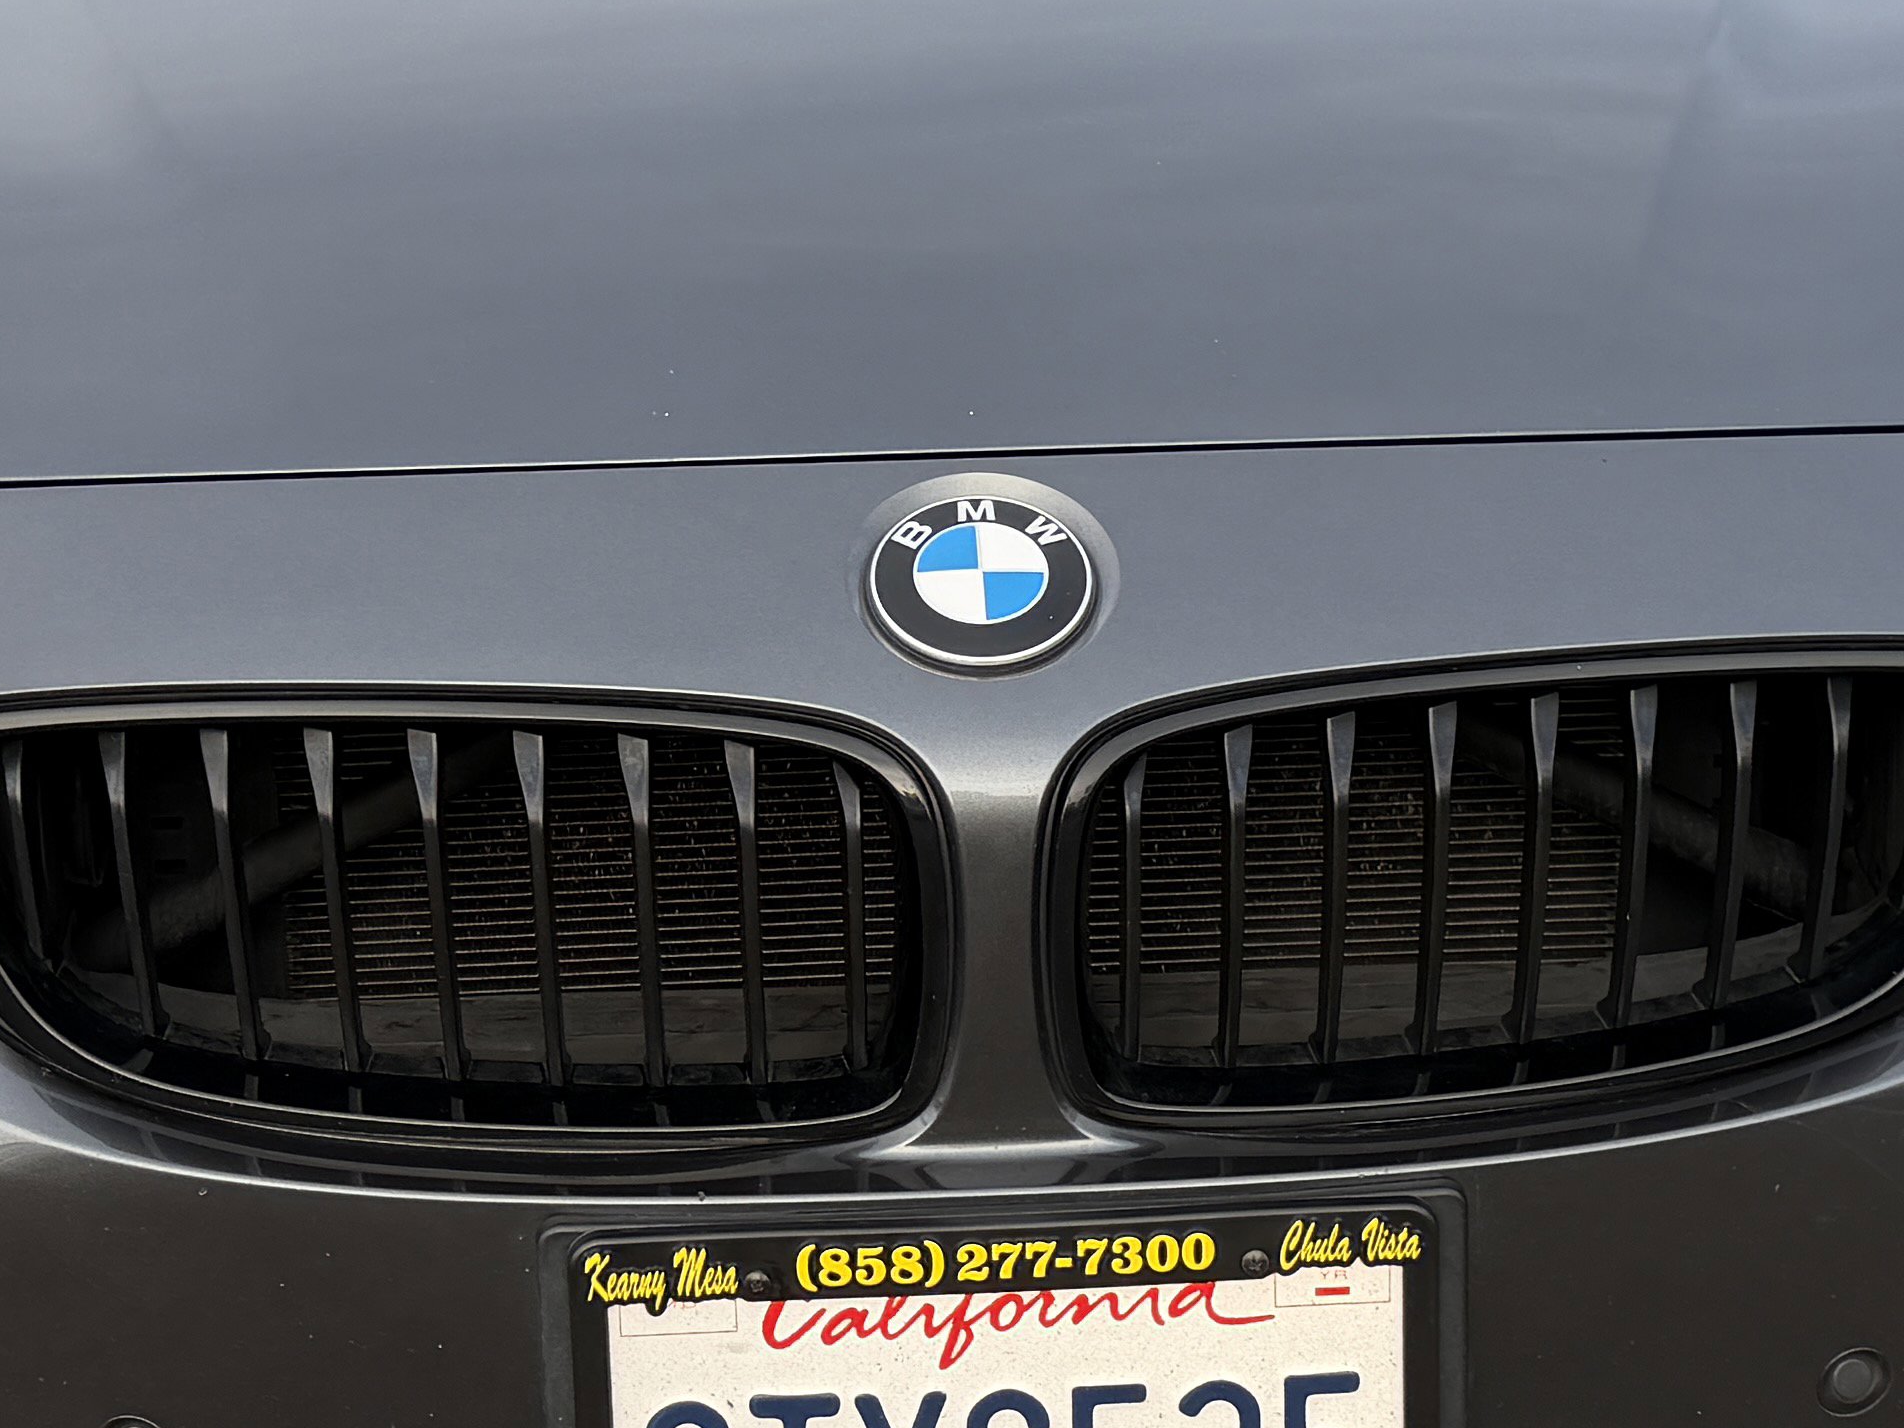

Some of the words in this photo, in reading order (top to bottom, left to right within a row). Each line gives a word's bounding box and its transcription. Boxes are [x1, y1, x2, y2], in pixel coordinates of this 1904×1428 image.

[890, 498, 1069, 551] BMW
[795, 1239, 945, 1293] (858)
[956, 1231, 1217, 1283] 277-7300
[1279, 1219, 1353, 1272] Chula
[1361, 1217, 1423, 1262] Vista
[584, 1252, 667, 1312] Kearny
[672, 1245, 740, 1299] Mesa
